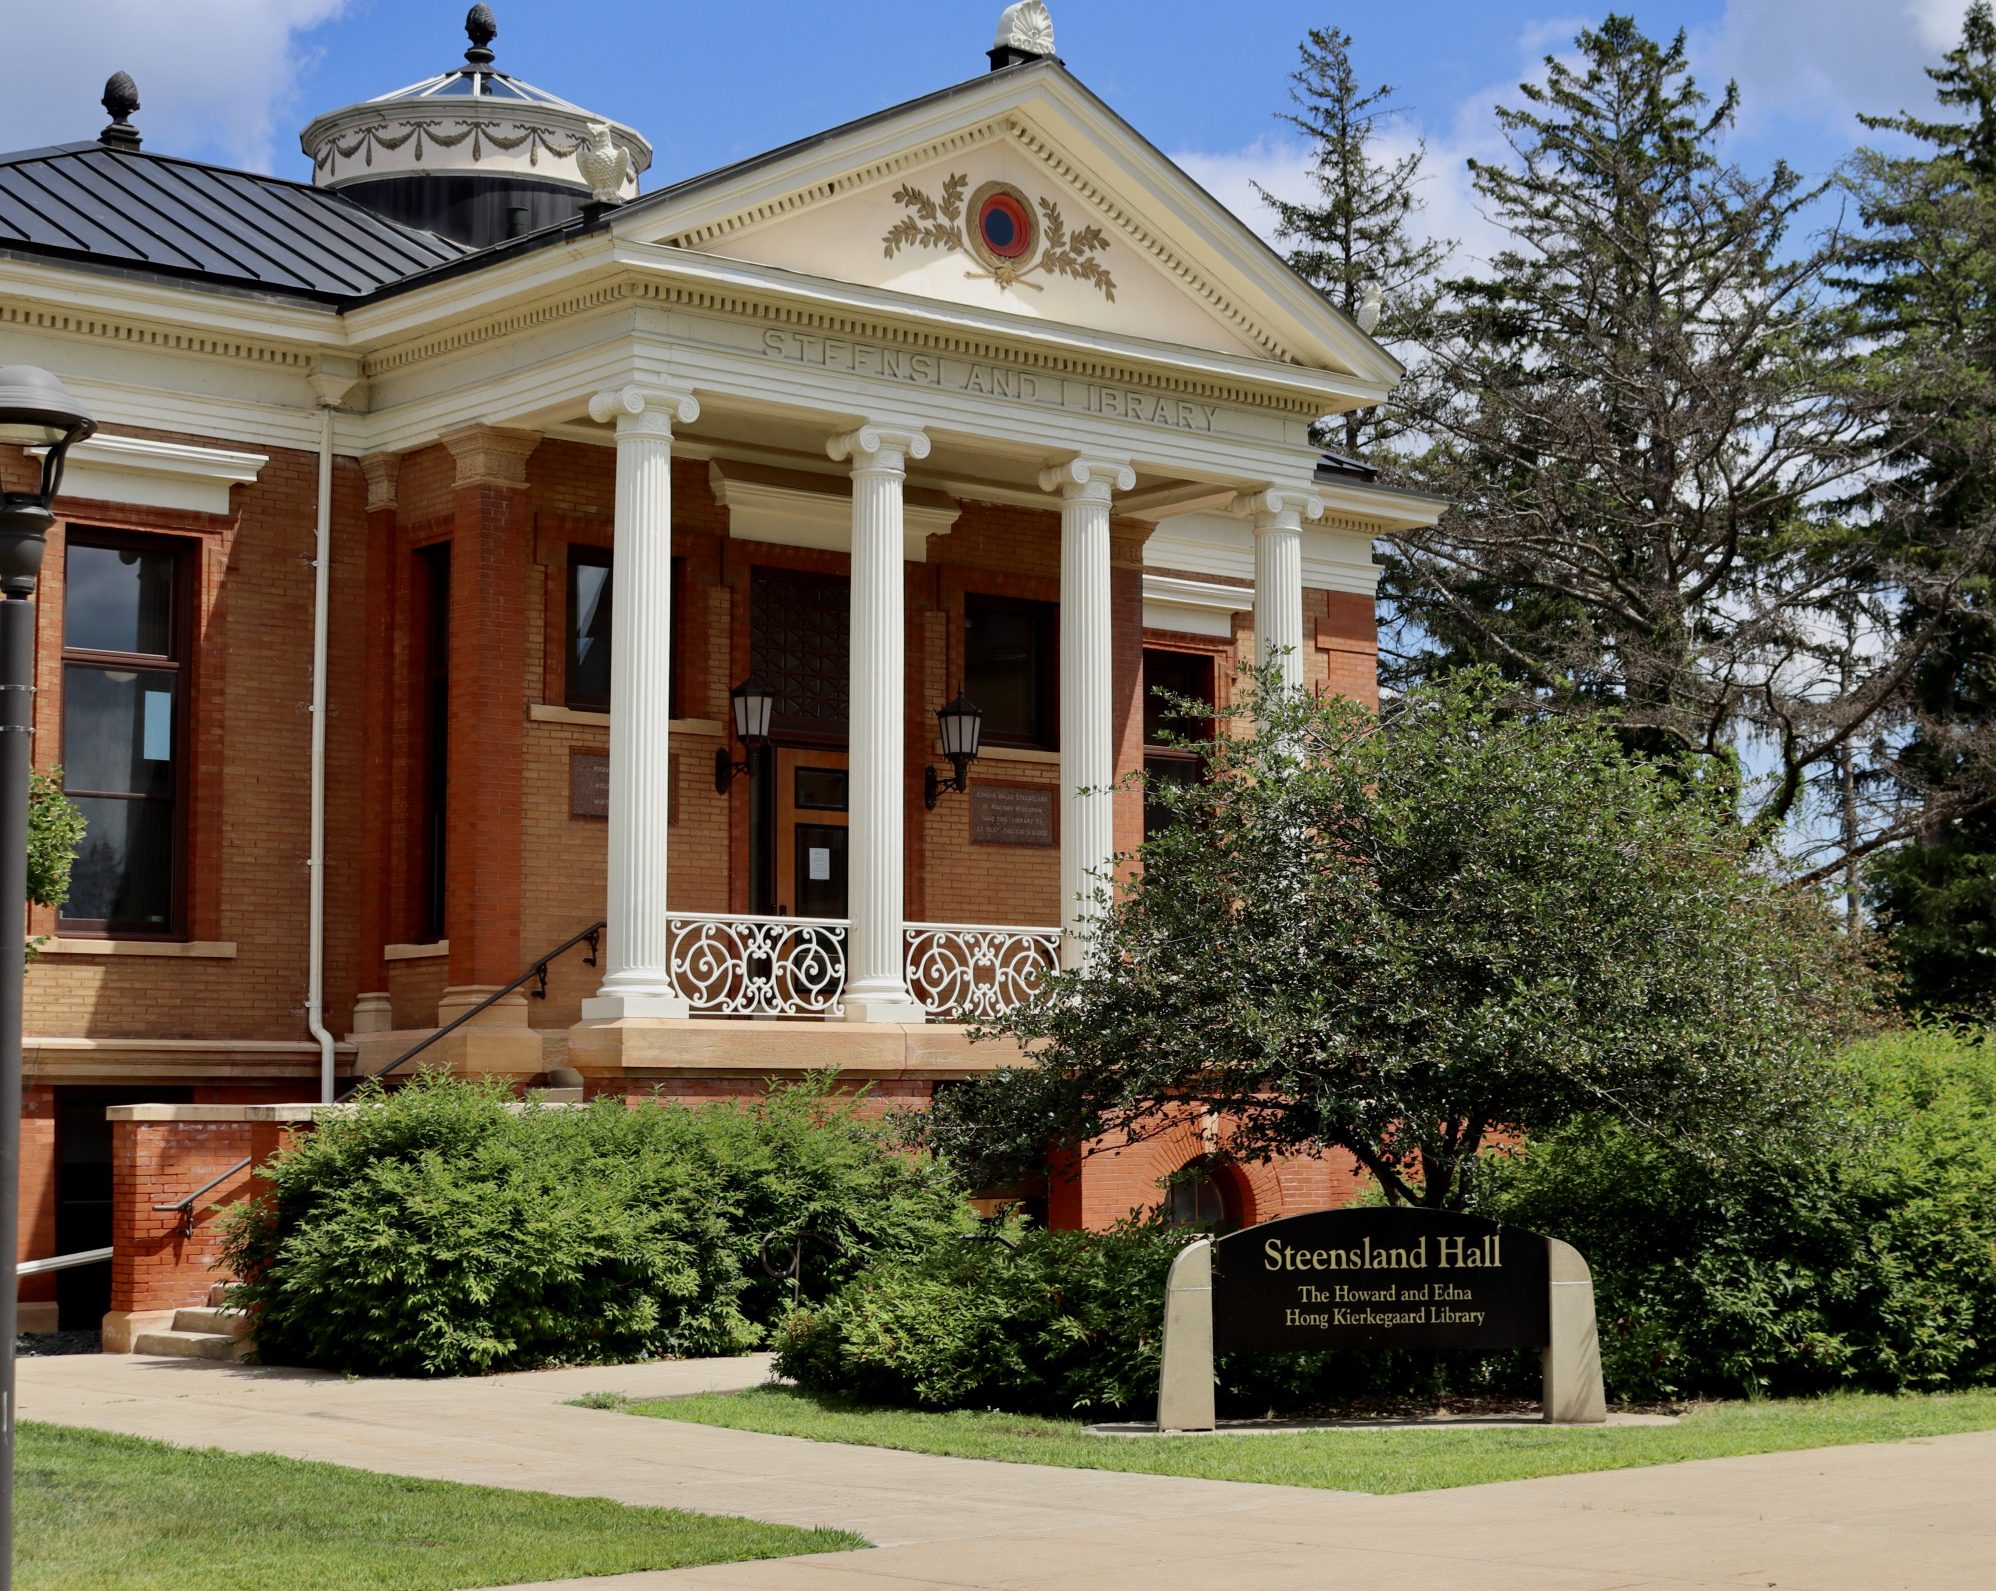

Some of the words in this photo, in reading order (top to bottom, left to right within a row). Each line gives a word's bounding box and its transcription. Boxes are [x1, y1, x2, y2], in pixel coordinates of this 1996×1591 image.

[762, 328, 1039, 401] STEENSLAND
[1060, 379, 1220, 432] LIBRARY
[1264, 1236, 1428, 1271] Steensland
[1436, 1234, 1503, 1268] Hall
[1297, 1285, 1330, 1303] The
[1334, 1284, 1396, 1302] Howard
[1400, 1283, 1429, 1301] and
[1433, 1283, 1473, 1301] Edna
[1285, 1308, 1329, 1329] Hong
[1332, 1306, 1426, 1328] Kierkegaard
[1430, 1306, 1486, 1327] Library
